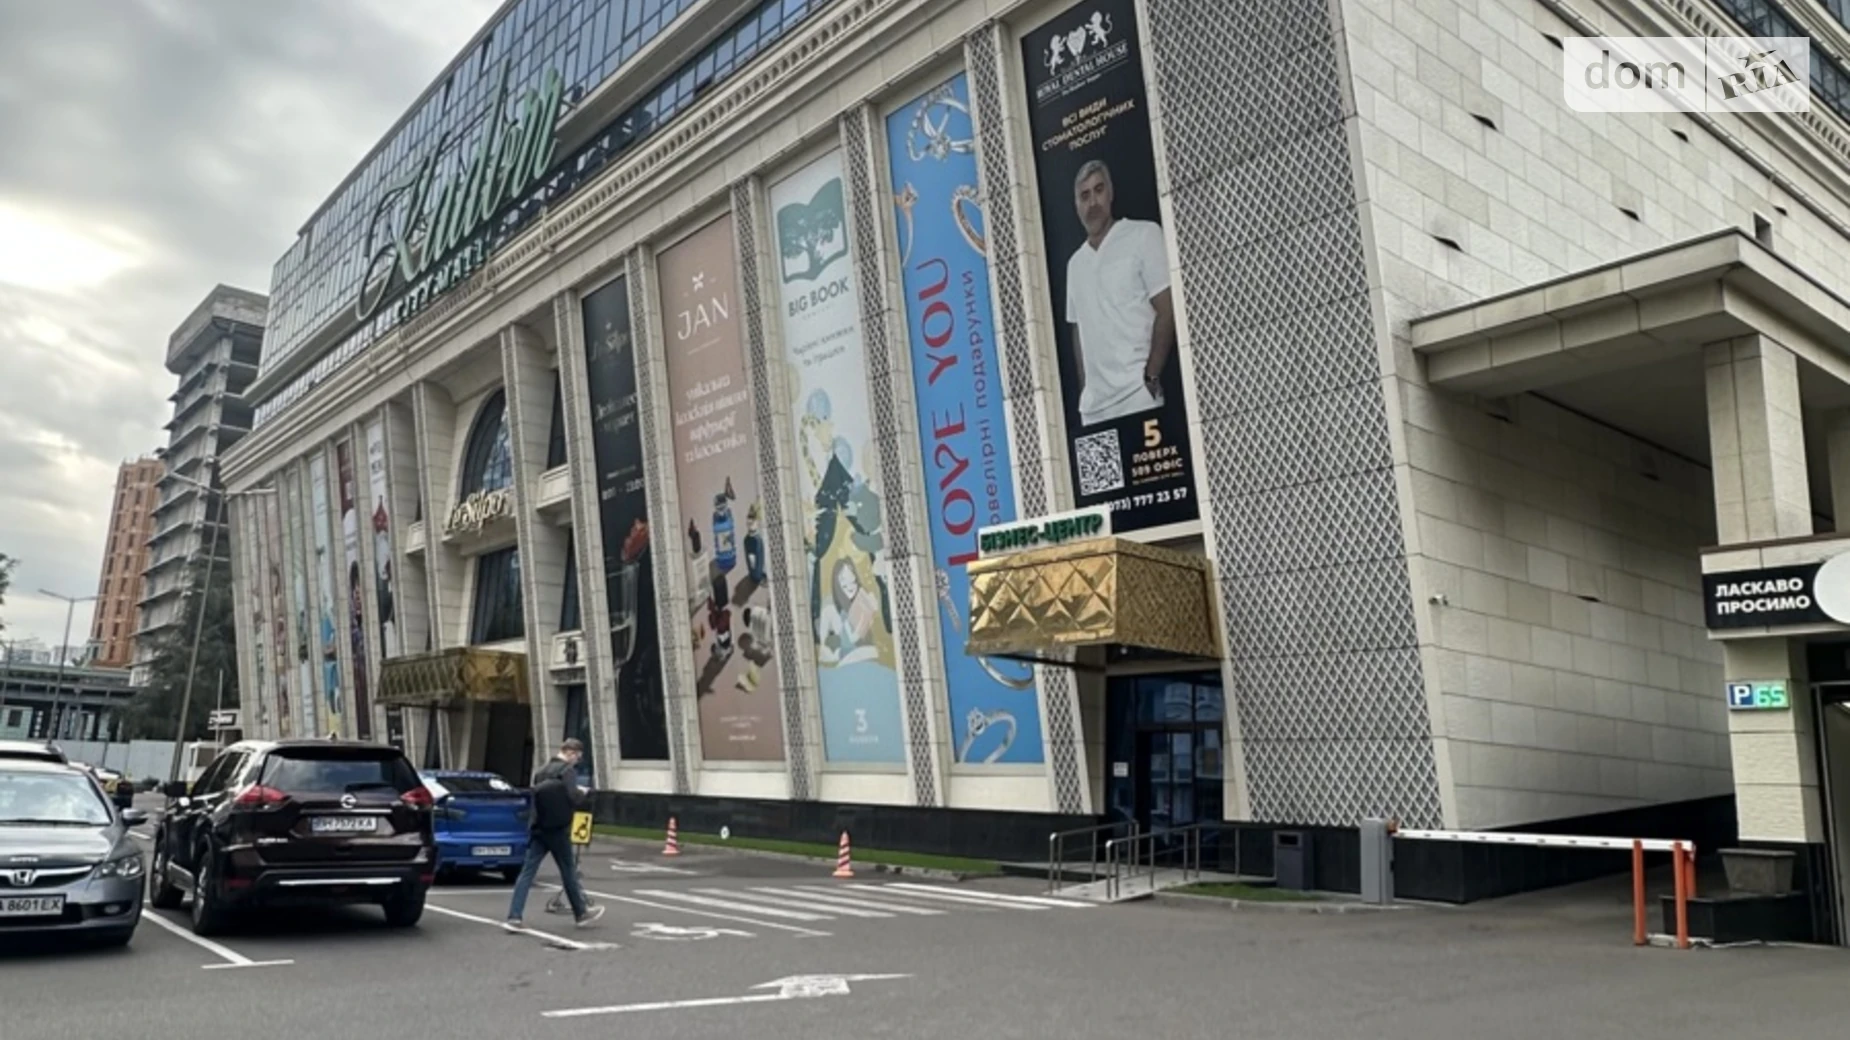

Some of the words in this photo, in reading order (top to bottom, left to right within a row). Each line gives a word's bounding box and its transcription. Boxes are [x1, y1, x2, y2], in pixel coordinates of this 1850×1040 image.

[1062, 59, 1095, 85] DENTAL
[1095, 42, 1129, 67] HOUSE
[1078, 97, 1107, 119] ВИДИ
[1041, 98, 1136, 151] СТОМАТОЛОГІЧНИХ
[1068, 124, 1108, 151] ПОСЛУГ
[788, 294, 808, 318] BIG
[809, 276, 850, 308] BOOK
[678, 291, 729, 340] JAN
[916, 257, 959, 388] YOU
[961, 269, 988, 410] подарунки
[1143, 418, 1162, 448] 5
[1132, 445, 1179, 464] ПОВЕРХ
[1153, 457, 1184, 473] ОФІС
[931, 402, 979, 567] LOVE
[1133, 492, 1155, 507] 777
[1156, 490, 1171, 503] 23
[1173, 486, 1188, 500] 57
[980, 513, 1104, 553] БІЗНЕС-ЦЕНТР
[1715, 577, 1804, 598] ЛАСКАВО
[1717, 595, 1811, 615] ПРОСИМО
[1733, 685, 1751, 705] P
[854, 708, 868, 733] 3
[8, 899, 38, 911] 8601
